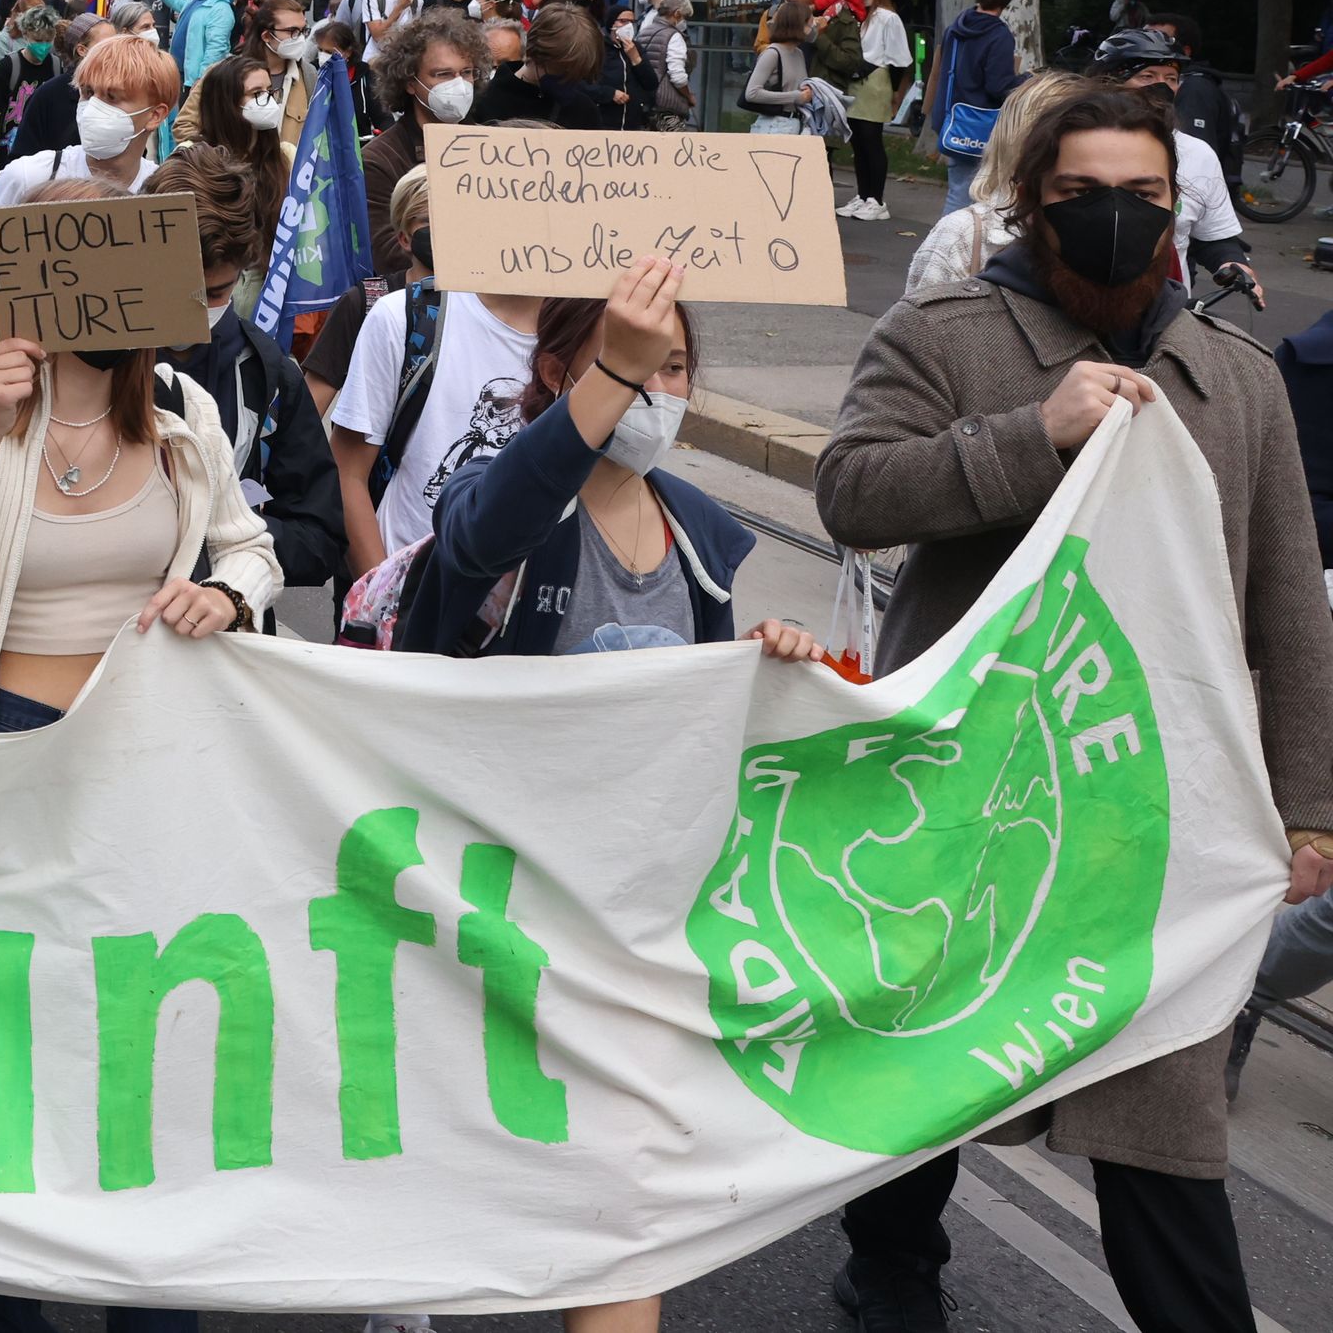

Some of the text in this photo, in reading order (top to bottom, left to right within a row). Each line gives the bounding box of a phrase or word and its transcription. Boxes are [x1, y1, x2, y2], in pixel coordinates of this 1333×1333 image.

[440, 135, 730, 172] Euch gehen die
[950, 136, 987, 149] adida
[137, 208, 188, 245] IF
[500, 245, 573, 275] uns
[583, 223, 634, 271] die
[654, 221, 746, 270] Zeit
[41, 259, 79, 289] IS
[968, 955, 1108, 1092] Wien
